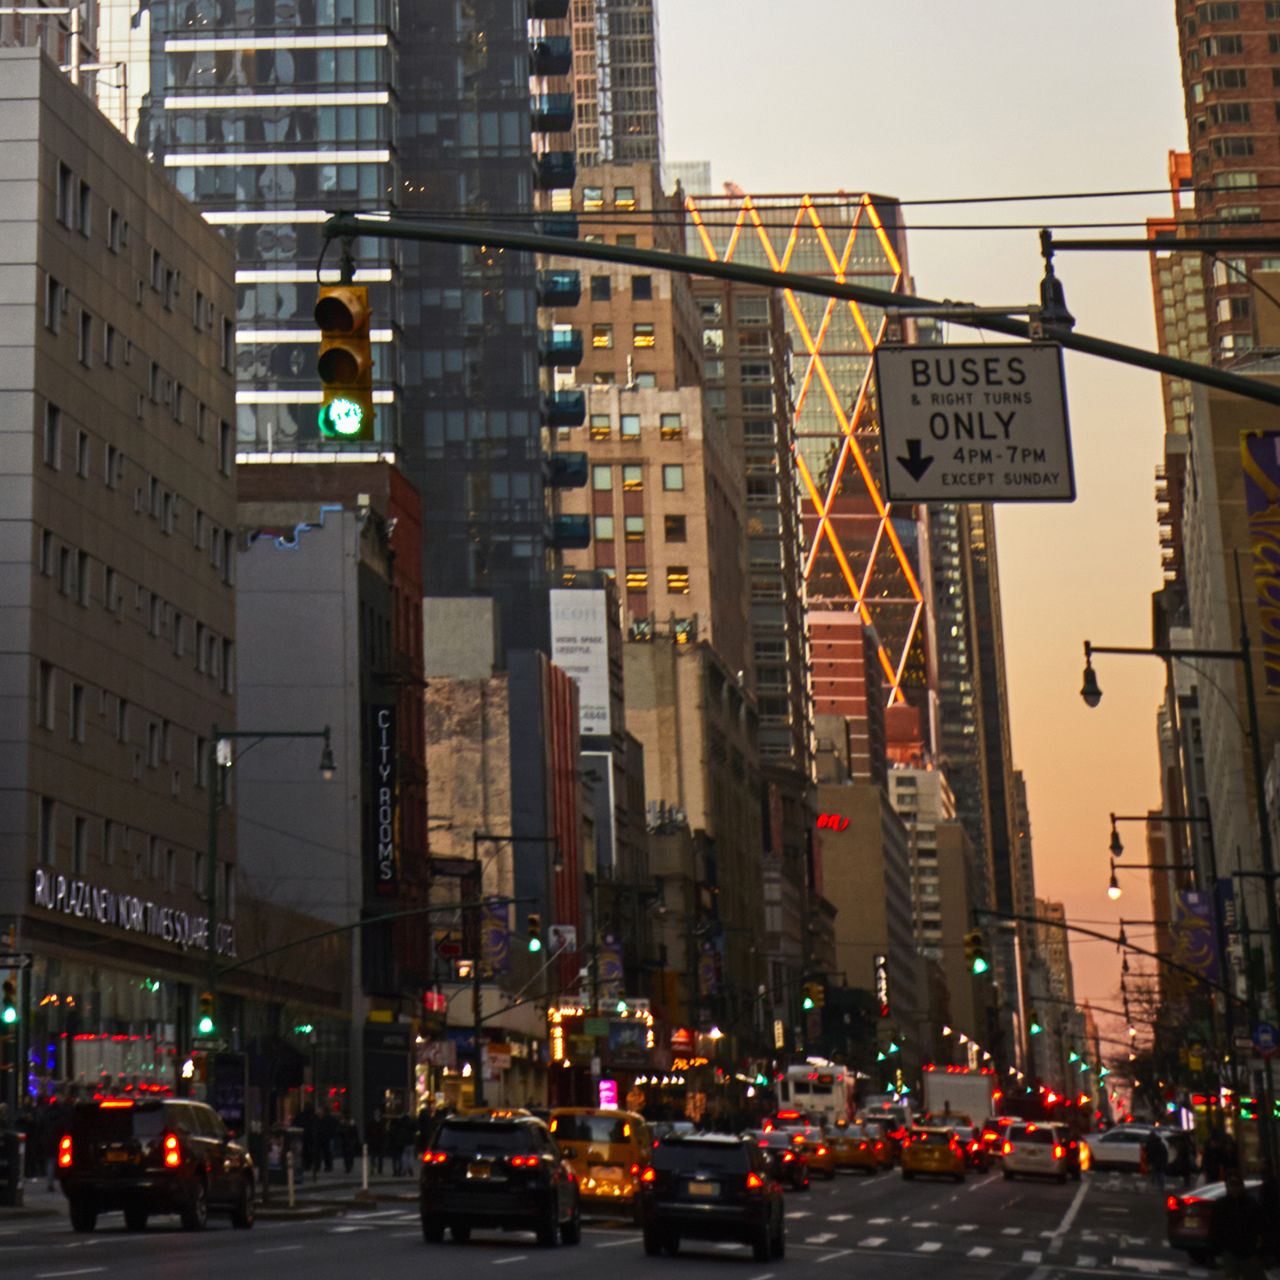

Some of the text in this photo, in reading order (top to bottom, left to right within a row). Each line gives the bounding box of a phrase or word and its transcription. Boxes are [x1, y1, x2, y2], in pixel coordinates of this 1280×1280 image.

[911, 357, 1027, 387] BUSES
[911, 392, 1033, 406] & RIGHT TURNS
[929, 411, 1016, 440] ONLY
[942, 472, 1060, 486] EXCEPT SUNDAY
[377, 709, 393, 880] CITY ROOMS
[35, 868, 56, 910] RIU
[56, 874, 91, 919] PLAZA
